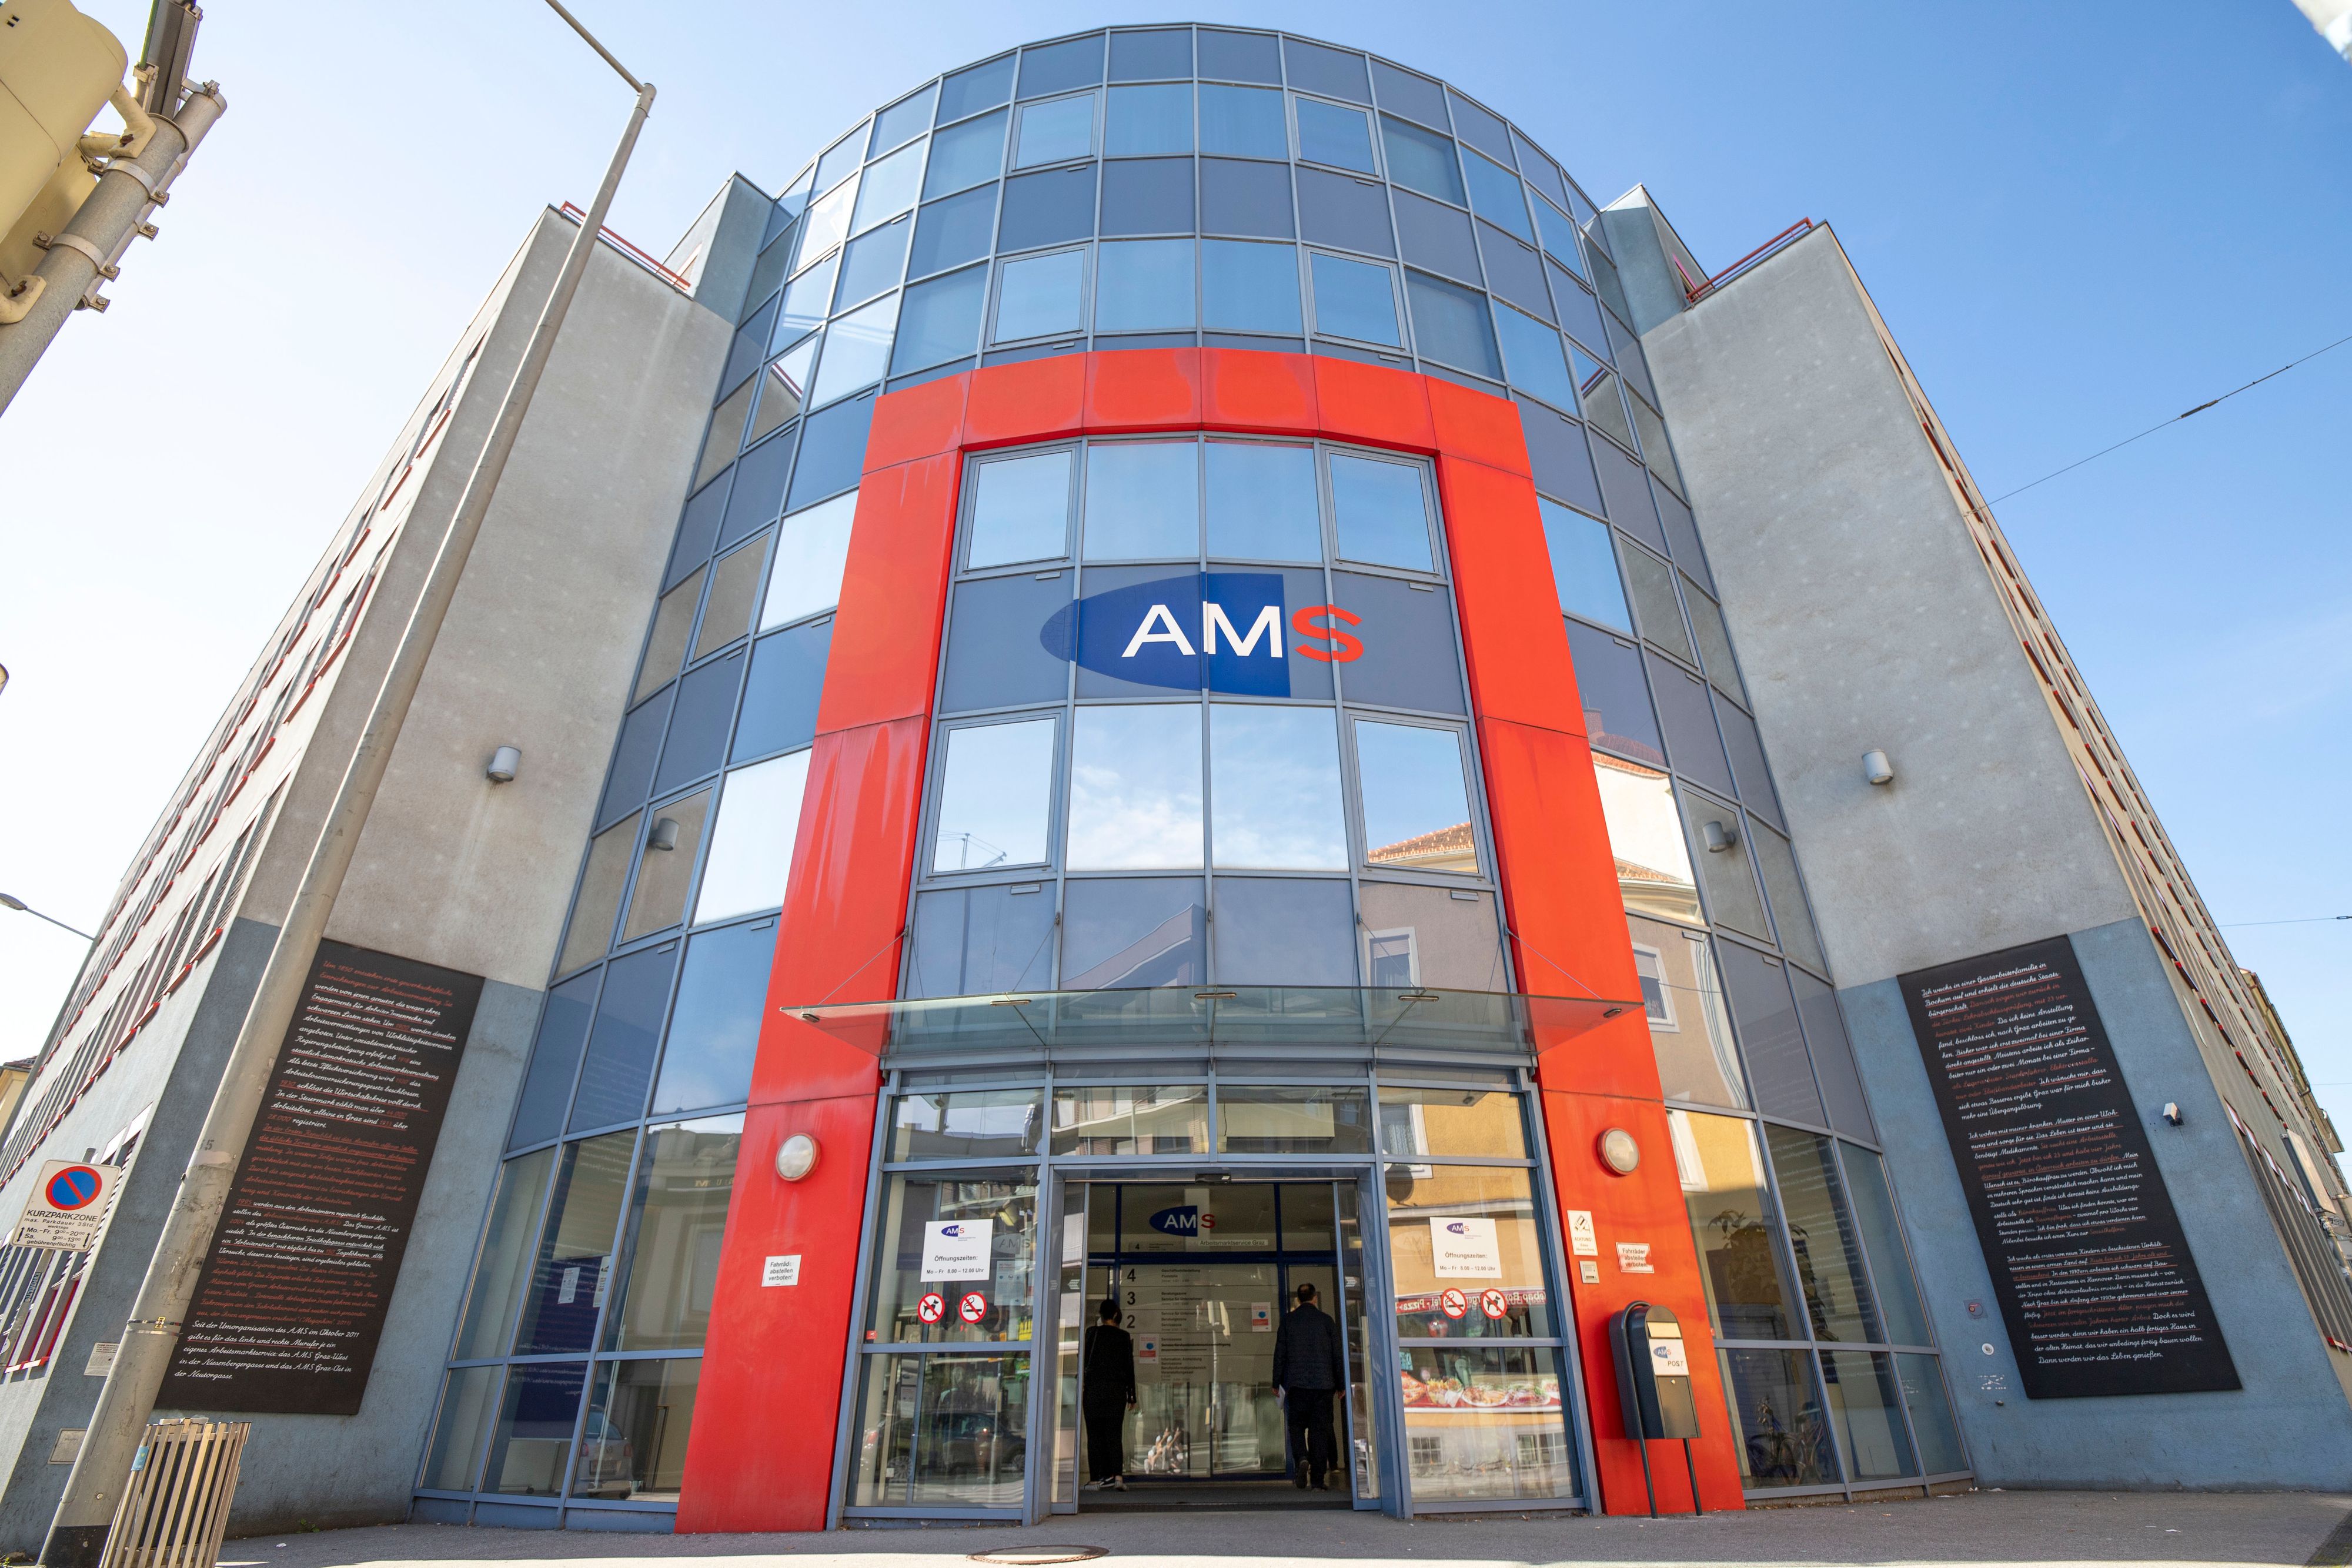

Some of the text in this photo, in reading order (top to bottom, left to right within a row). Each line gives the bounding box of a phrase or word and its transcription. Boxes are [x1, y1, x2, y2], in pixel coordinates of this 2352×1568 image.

[1121, 601, 1364, 663] AMS
[1921, 988, 1932, 996] Ich
[1932, 984, 1952, 994] wuchs
[1976, 963, 2038, 984] Gastarbeiterfamilie
[1925, 997, 1952, 1007] Bochum
[1952, 991, 1964, 1000] auf
[1964, 989, 1977, 998] und
[1977, 984, 1998, 994] erhielt
[2009, 975, 2037, 987] deutsche
[302, 1015, 370, 1034] Arbeitsvermittlungen
[335, 1032, 353, 1041] Unter
[353, 1038, 417, 1054] sozialdemokratischer
[365, 1050, 387, 1060] erfolgt
[1986, 1064, 2001, 1072] oder
[2016, 1057, 2042, 1066] Monate
[2068, 1048, 2090, 1056] Firma
[275, 1089, 285, 1097] In
[298, 1093, 336, 1105] Steiermark
[334, 1101, 354, 1109] zählt
[1958, 1102, 1970, 1110] sich
[1989, 1096, 2013, 1105] Besseres
[2033, 1089, 2049, 1099] Graz
[2063, 1084, 2074, 1093] für
[2074, 1080, 2090, 1089] mich
[2091, 1078, 2112, 1086] bisher
[313, 1108, 336, 1118] alleine
[345, 1113, 363, 1122] Graz
[1961, 1112, 1976, 1120] mehr
[1974, 1151, 1998, 1159] benötigt
[26, 1209, 98, 1222] KURZPARKZONE
[1164, 1213, 1216, 1229] AMS
[26, 1240, 76, 1248] gebührenpflichtig
[1127, 1268, 1136, 1282] 4
[1127, 1292, 1135, 1305] 3
[192, 1319, 206, 1328] Seit
[218, 1321, 275, 1333] Umorganisation
[286, 1326, 309, 1335] AMS
[319, 1328, 345, 1336] Oktober
[1127, 1315, 1135, 1328] 2
[187, 1332, 204, 1342] gibt
[210, 1333, 224, 1343] für
[238, 1335, 256, 1343] linke
[289, 1339, 320, 1349] Murufer
[317, 1341, 326, 1350] je
[2108, 1339, 2140, 1348] unbedingt
[2140, 1338, 2159, 1347] fertig
[183, 1345, 208, 1355] eigenes
[290, 1350, 313, 1359] AMS
[313, 1352, 349, 1361] Graz-West
[2038, 1356, 2058, 1364] Dann
[2057, 1355, 2082, 1363] werden
[2110, 1352, 2132, 1360] Leben
[292, 1362, 315, 1370] AMS
[314, 1363, 345, 1373] Graz-Ost
